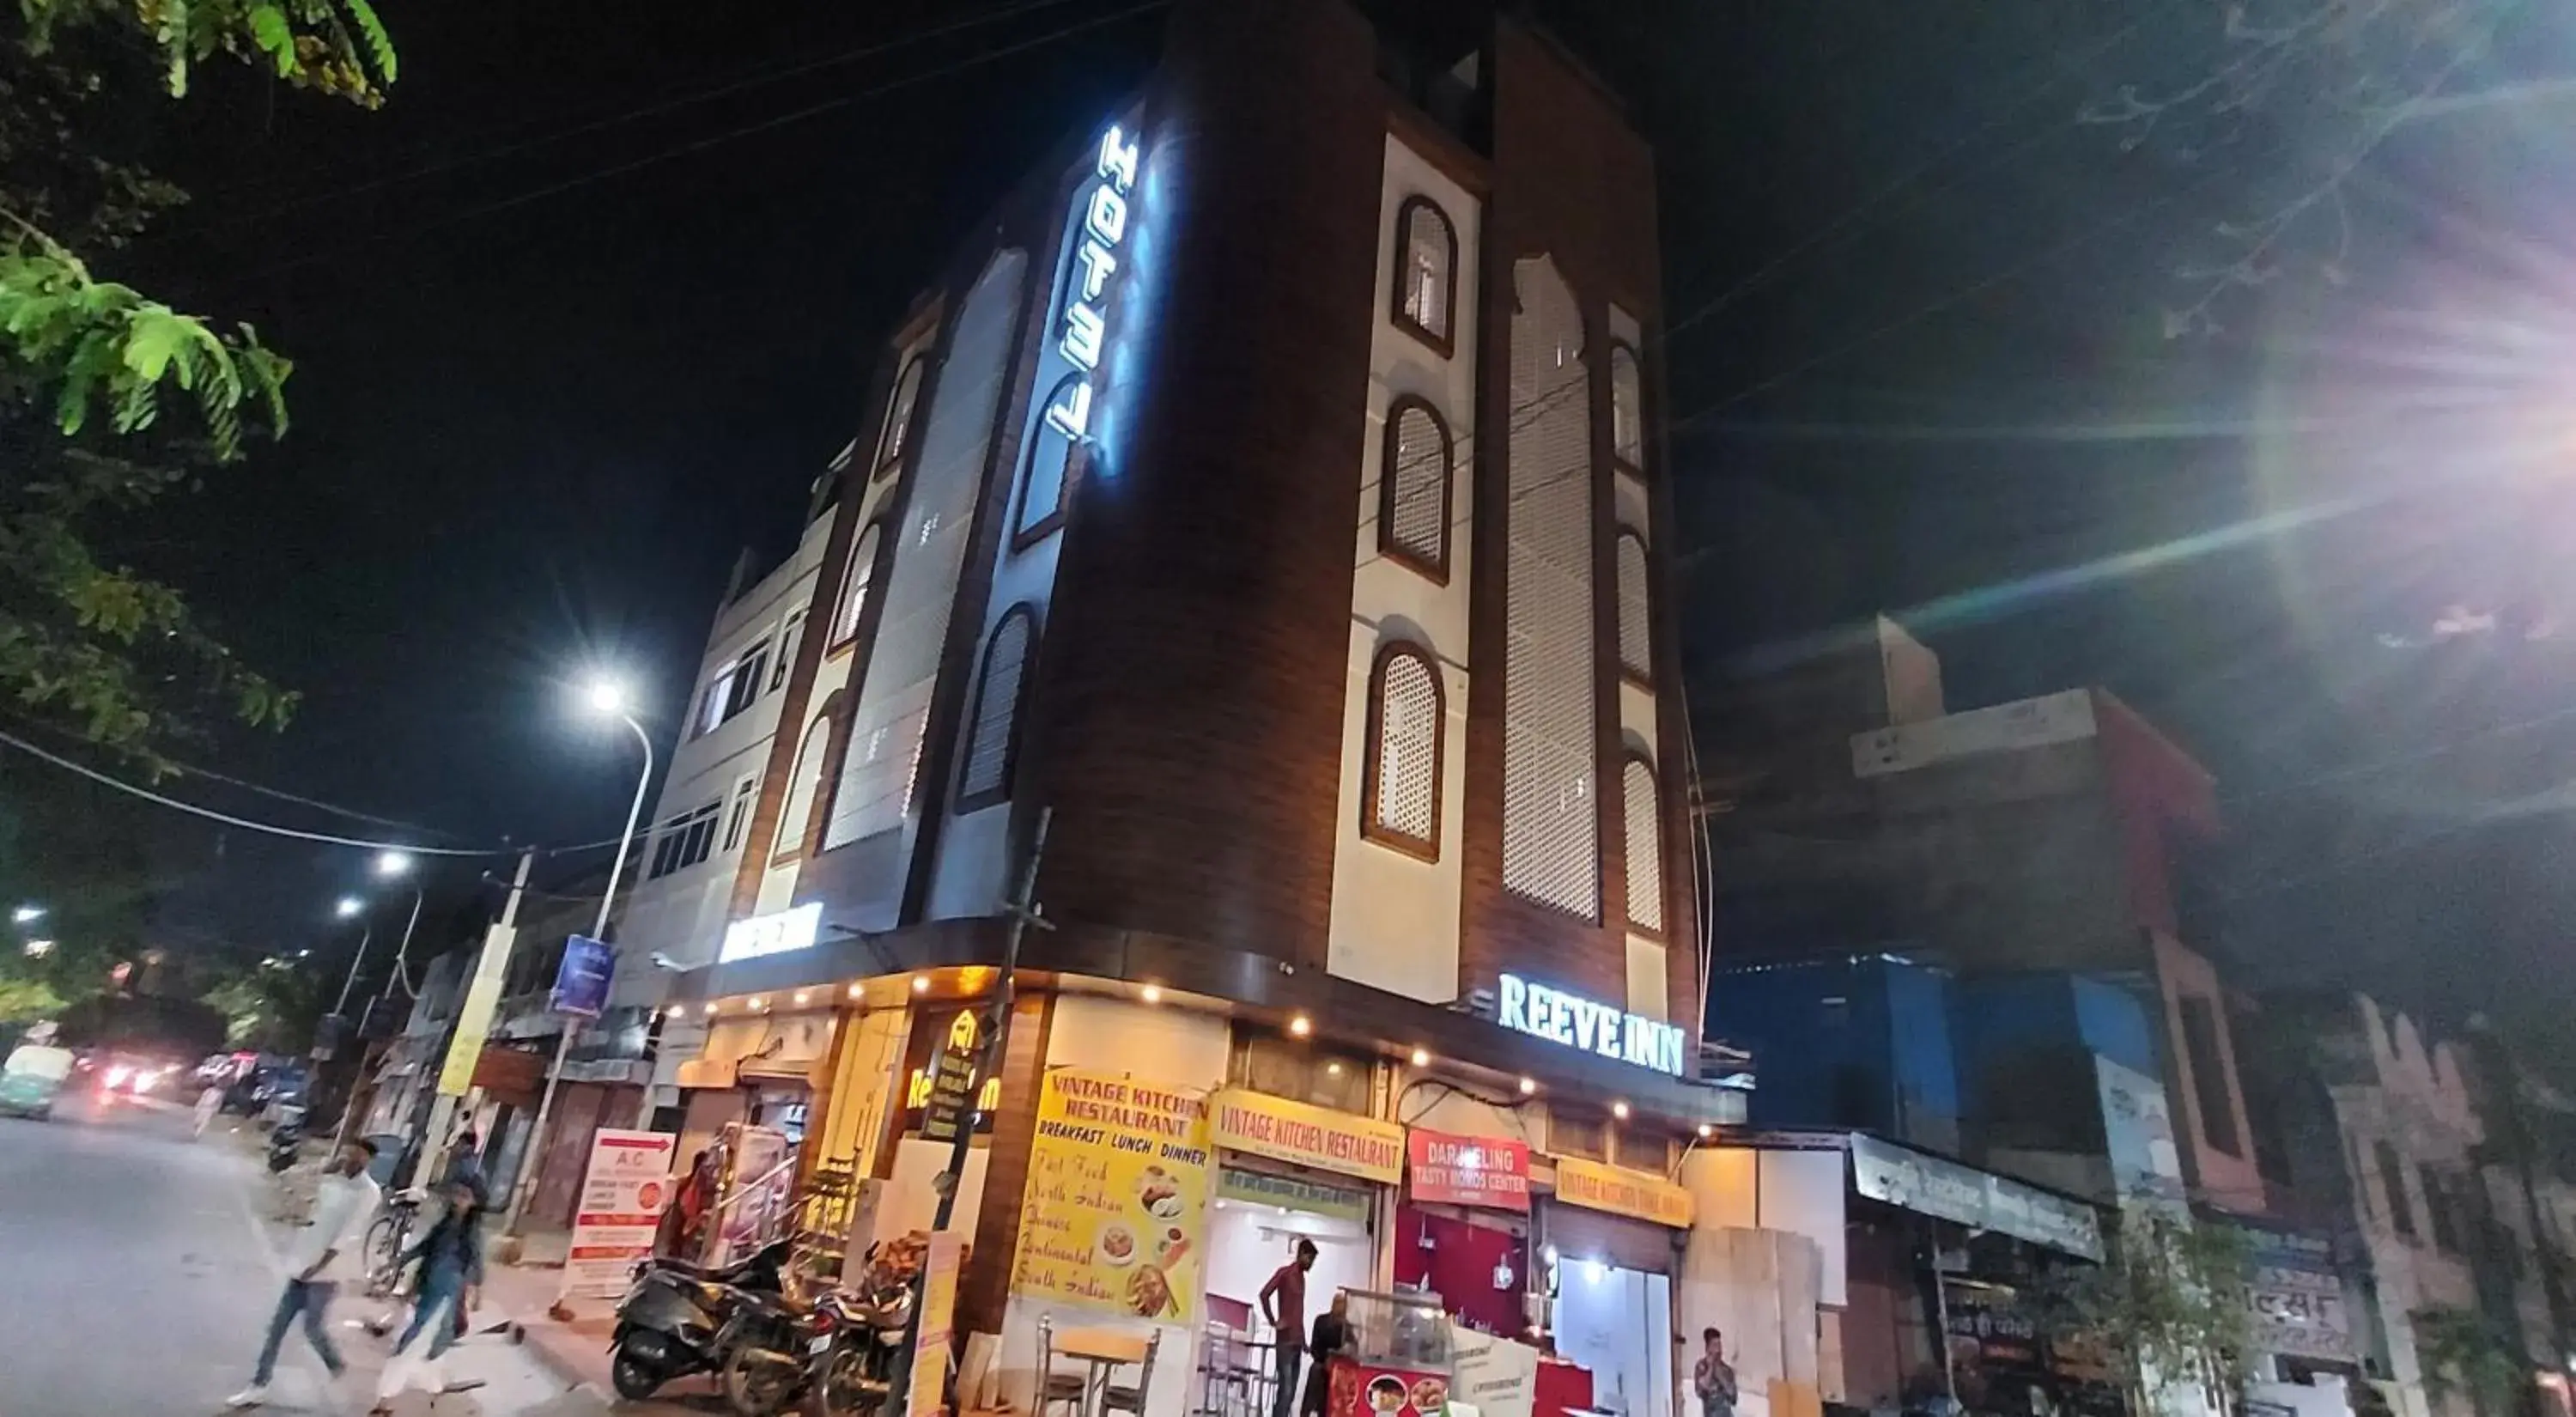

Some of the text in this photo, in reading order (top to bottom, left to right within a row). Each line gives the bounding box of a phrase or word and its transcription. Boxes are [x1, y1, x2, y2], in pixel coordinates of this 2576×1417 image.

[1046, 125, 1139, 441] HOTEL
[1498, 974, 1685, 1076] REEVE INN
[1052, 1075, 1210, 1121] VINTAGE KITCHEN
[1066, 1098, 1189, 1138] RESTAURANT
[1039, 1119, 1207, 1168] BREAKFAST LUNCH DINNER
[1219, 1104, 1273, 1141] VINTAGE
[1274, 1118, 1322, 1153] KITCHEN
[1326, 1129, 1400, 1169] RESTAURANT
[1413, 1166, 1447, 1186] TASTY
